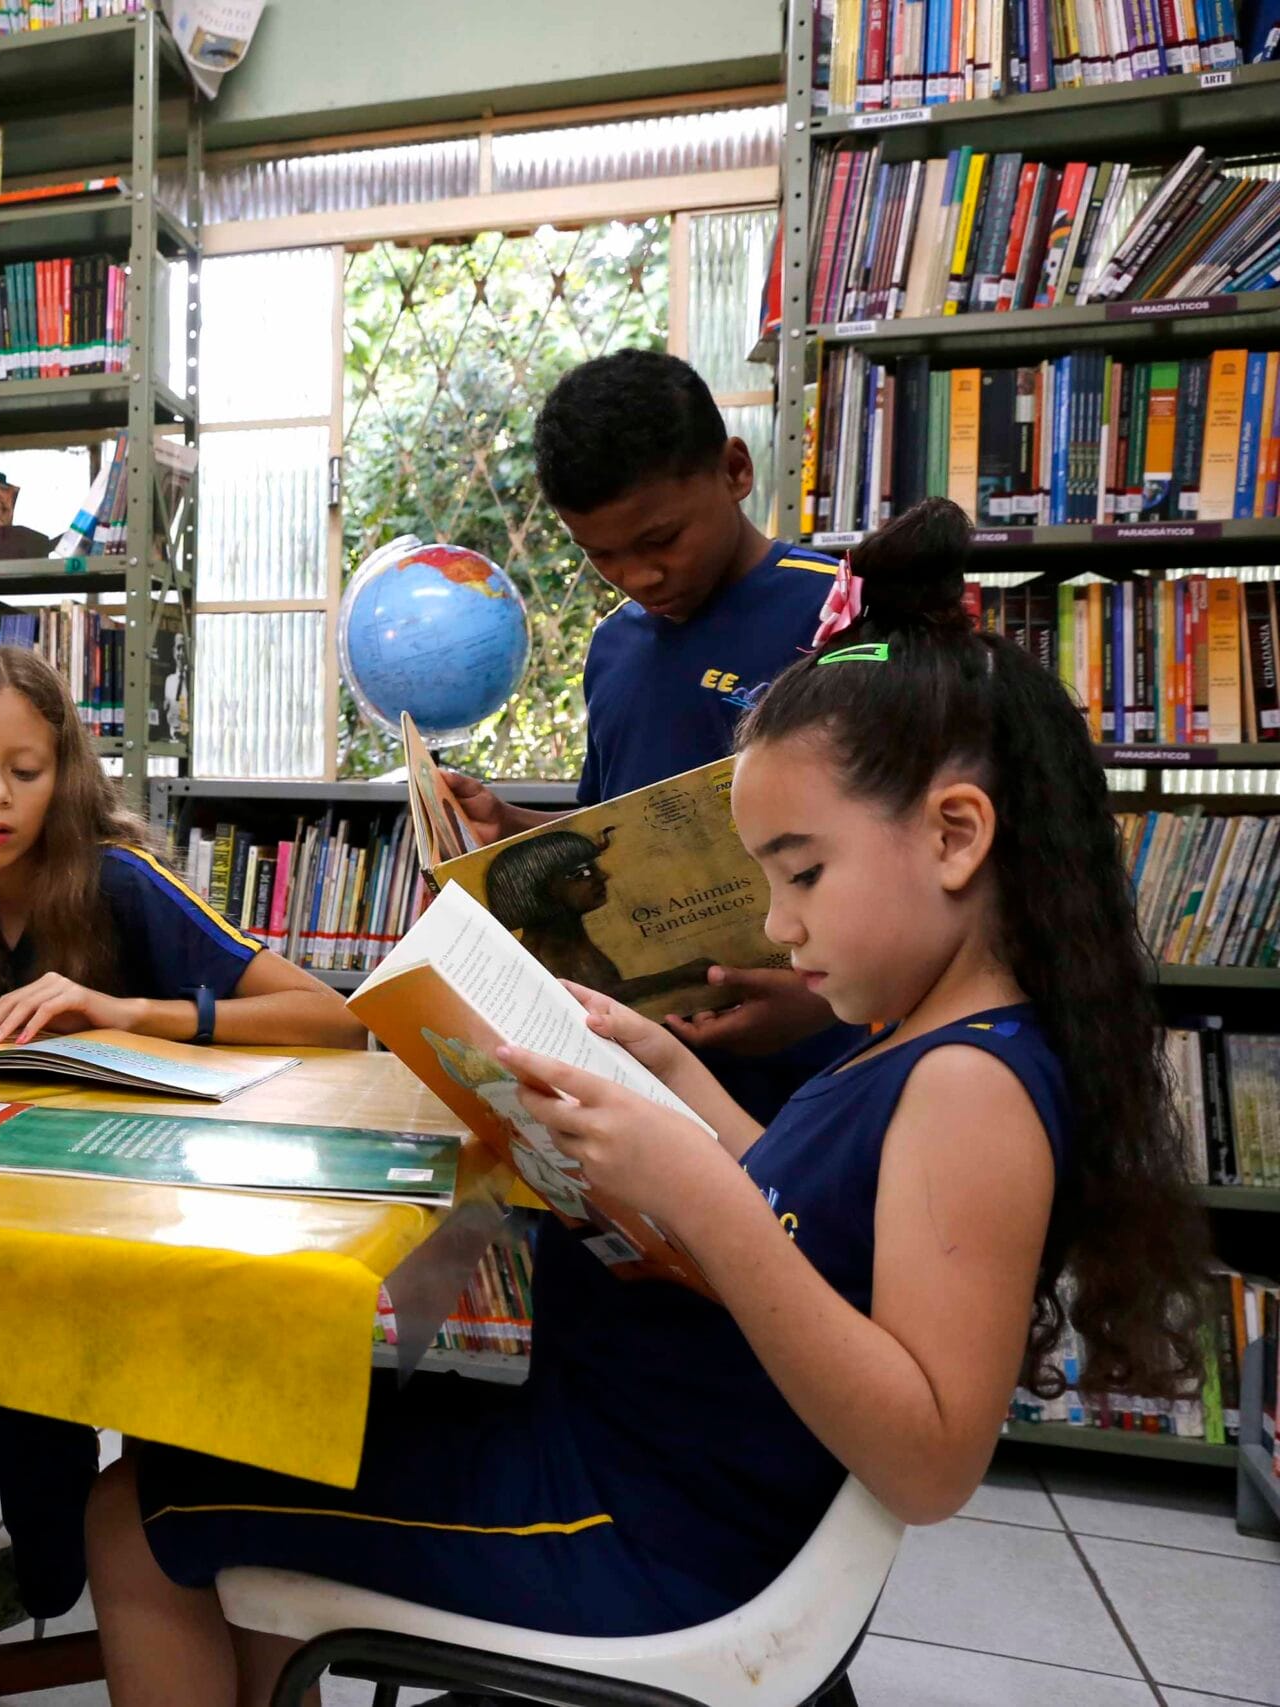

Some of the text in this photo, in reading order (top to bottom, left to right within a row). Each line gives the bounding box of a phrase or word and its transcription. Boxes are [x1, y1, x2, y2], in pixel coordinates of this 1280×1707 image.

[1203, 74, 1226, 85] ARTE
[1131, 301, 1210, 314] PARADIDÁTICOS
[1117, 528, 1195, 537] PARADIDÁTICOS
[1259, 624, 1275, 688] CIDADANIA
[1114, 751, 1191, 760] PARADIDÁTICOS
[631, 875, 751, 923] Os Animais
[638, 893, 755, 938] Fantásticos
